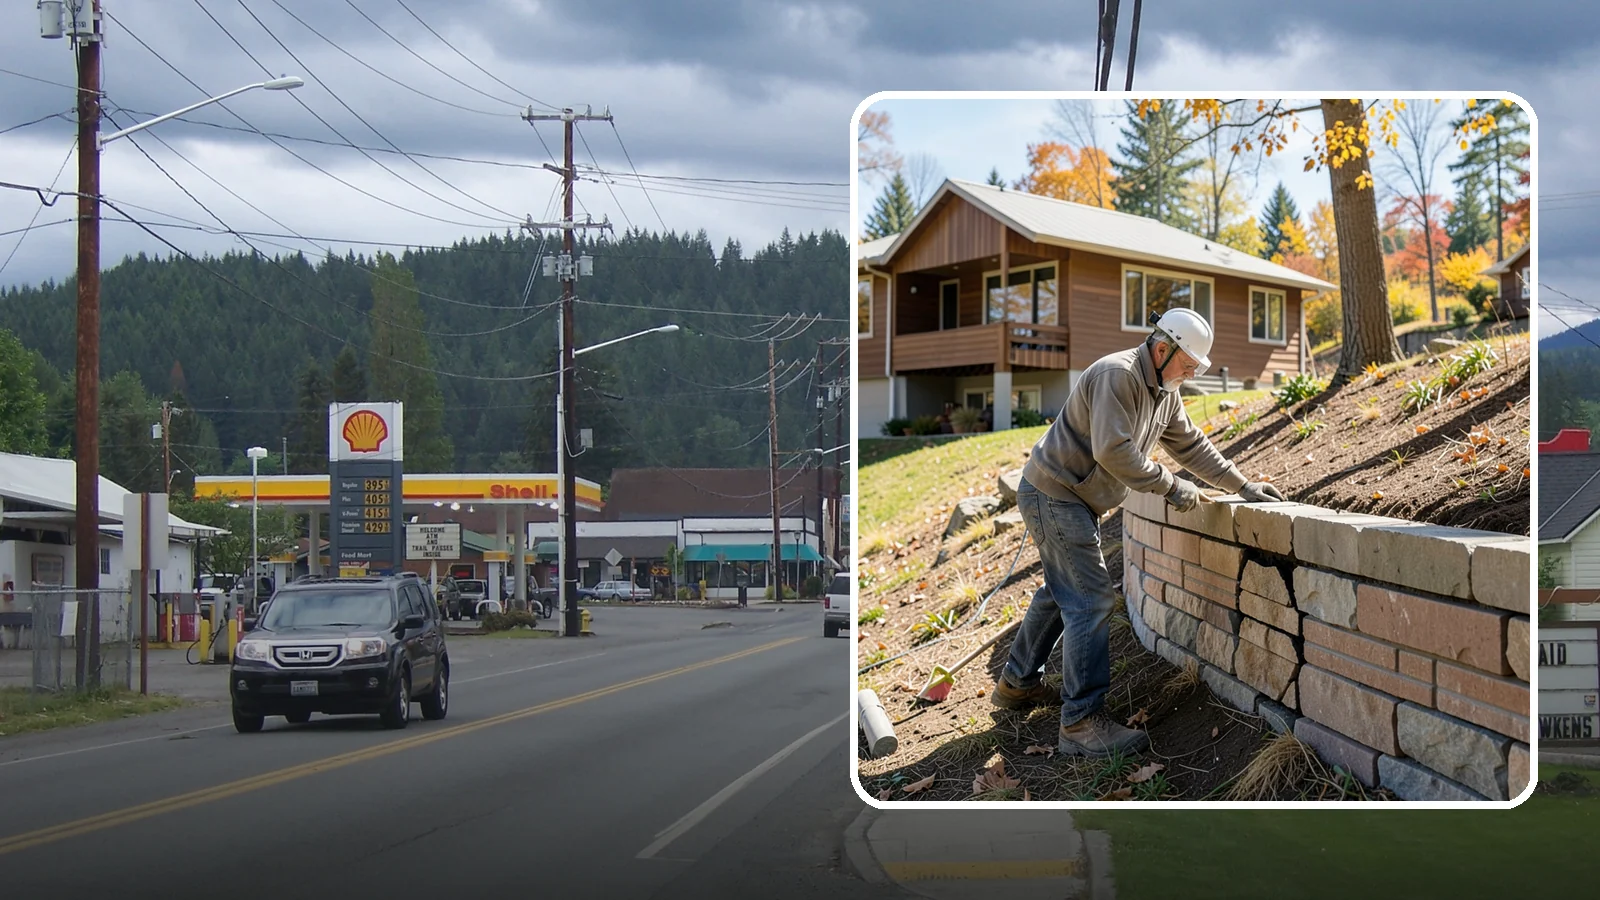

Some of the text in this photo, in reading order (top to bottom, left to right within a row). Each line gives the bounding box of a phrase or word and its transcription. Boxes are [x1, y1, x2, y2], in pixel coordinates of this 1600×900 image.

[366, 480, 383, 490] 395
[490, 484, 547, 499] Shell
[366, 494, 383, 504] 405
[366, 508, 383, 518] 415
[366, 522, 383, 532] 429
